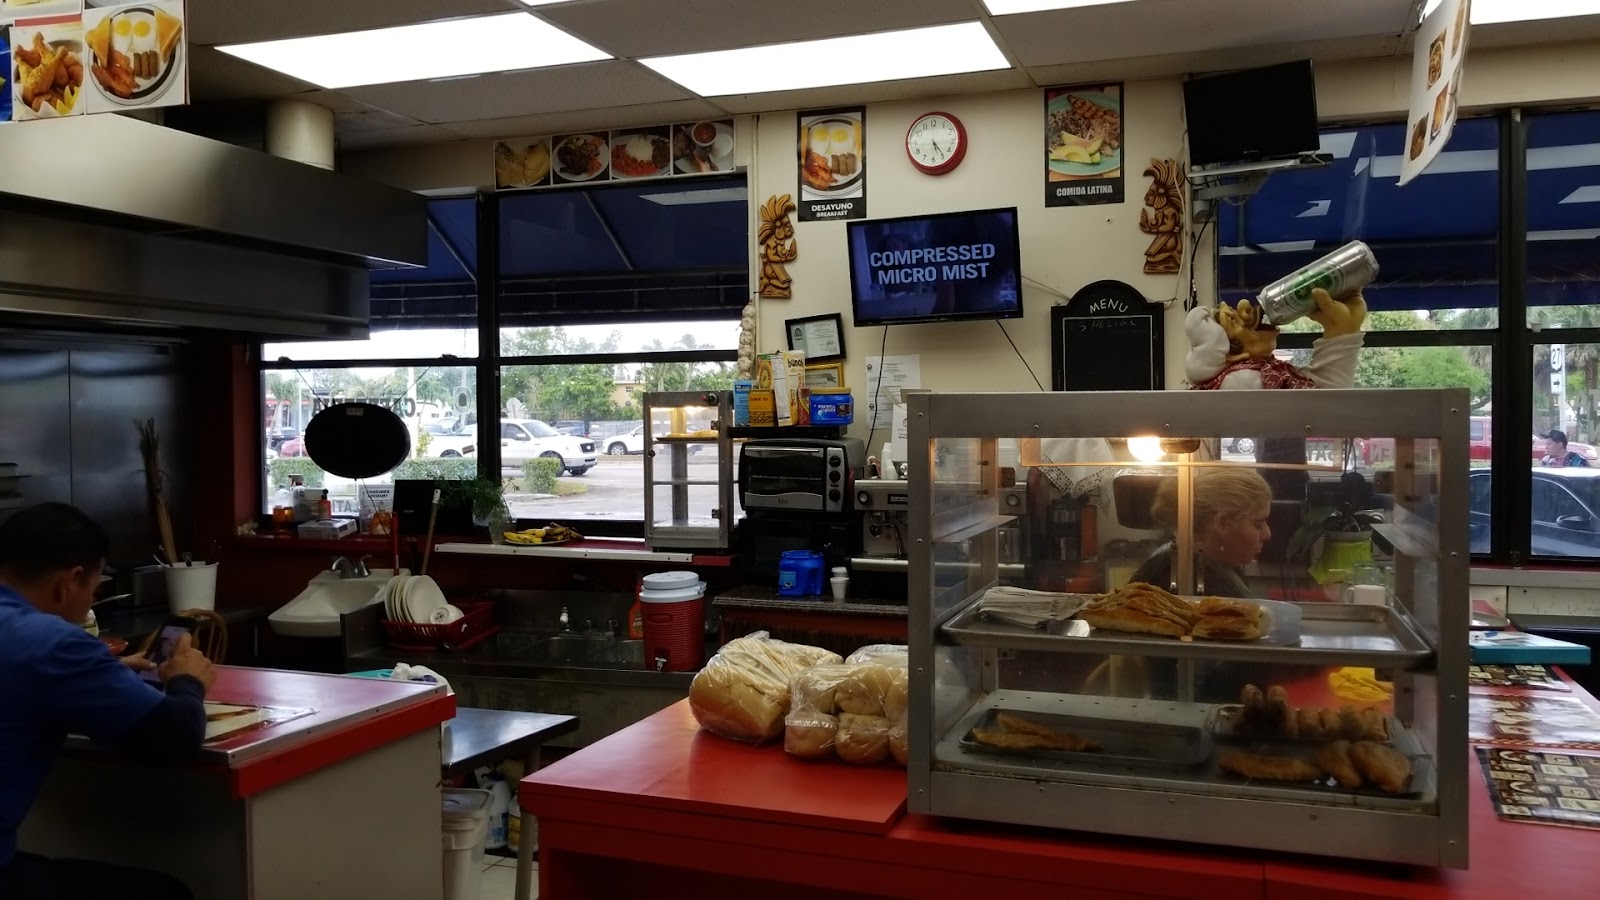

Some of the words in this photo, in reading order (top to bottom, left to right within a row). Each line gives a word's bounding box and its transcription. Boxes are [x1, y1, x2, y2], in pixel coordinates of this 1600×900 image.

[1056, 186, 1086, 197] COMIDA
[1087, 184, 1113, 195] LATINA
[811, 202, 854, 212] DESAYUNO
[816, 210, 849, 218] BREAKFAST
[869, 243, 996, 268] COMPRESSED
[878, 266, 937, 285] MICRO
[942, 262, 990, 281] MIST
[1089, 298, 1129, 314] MENU
[1552, 348, 1560, 365] 27
